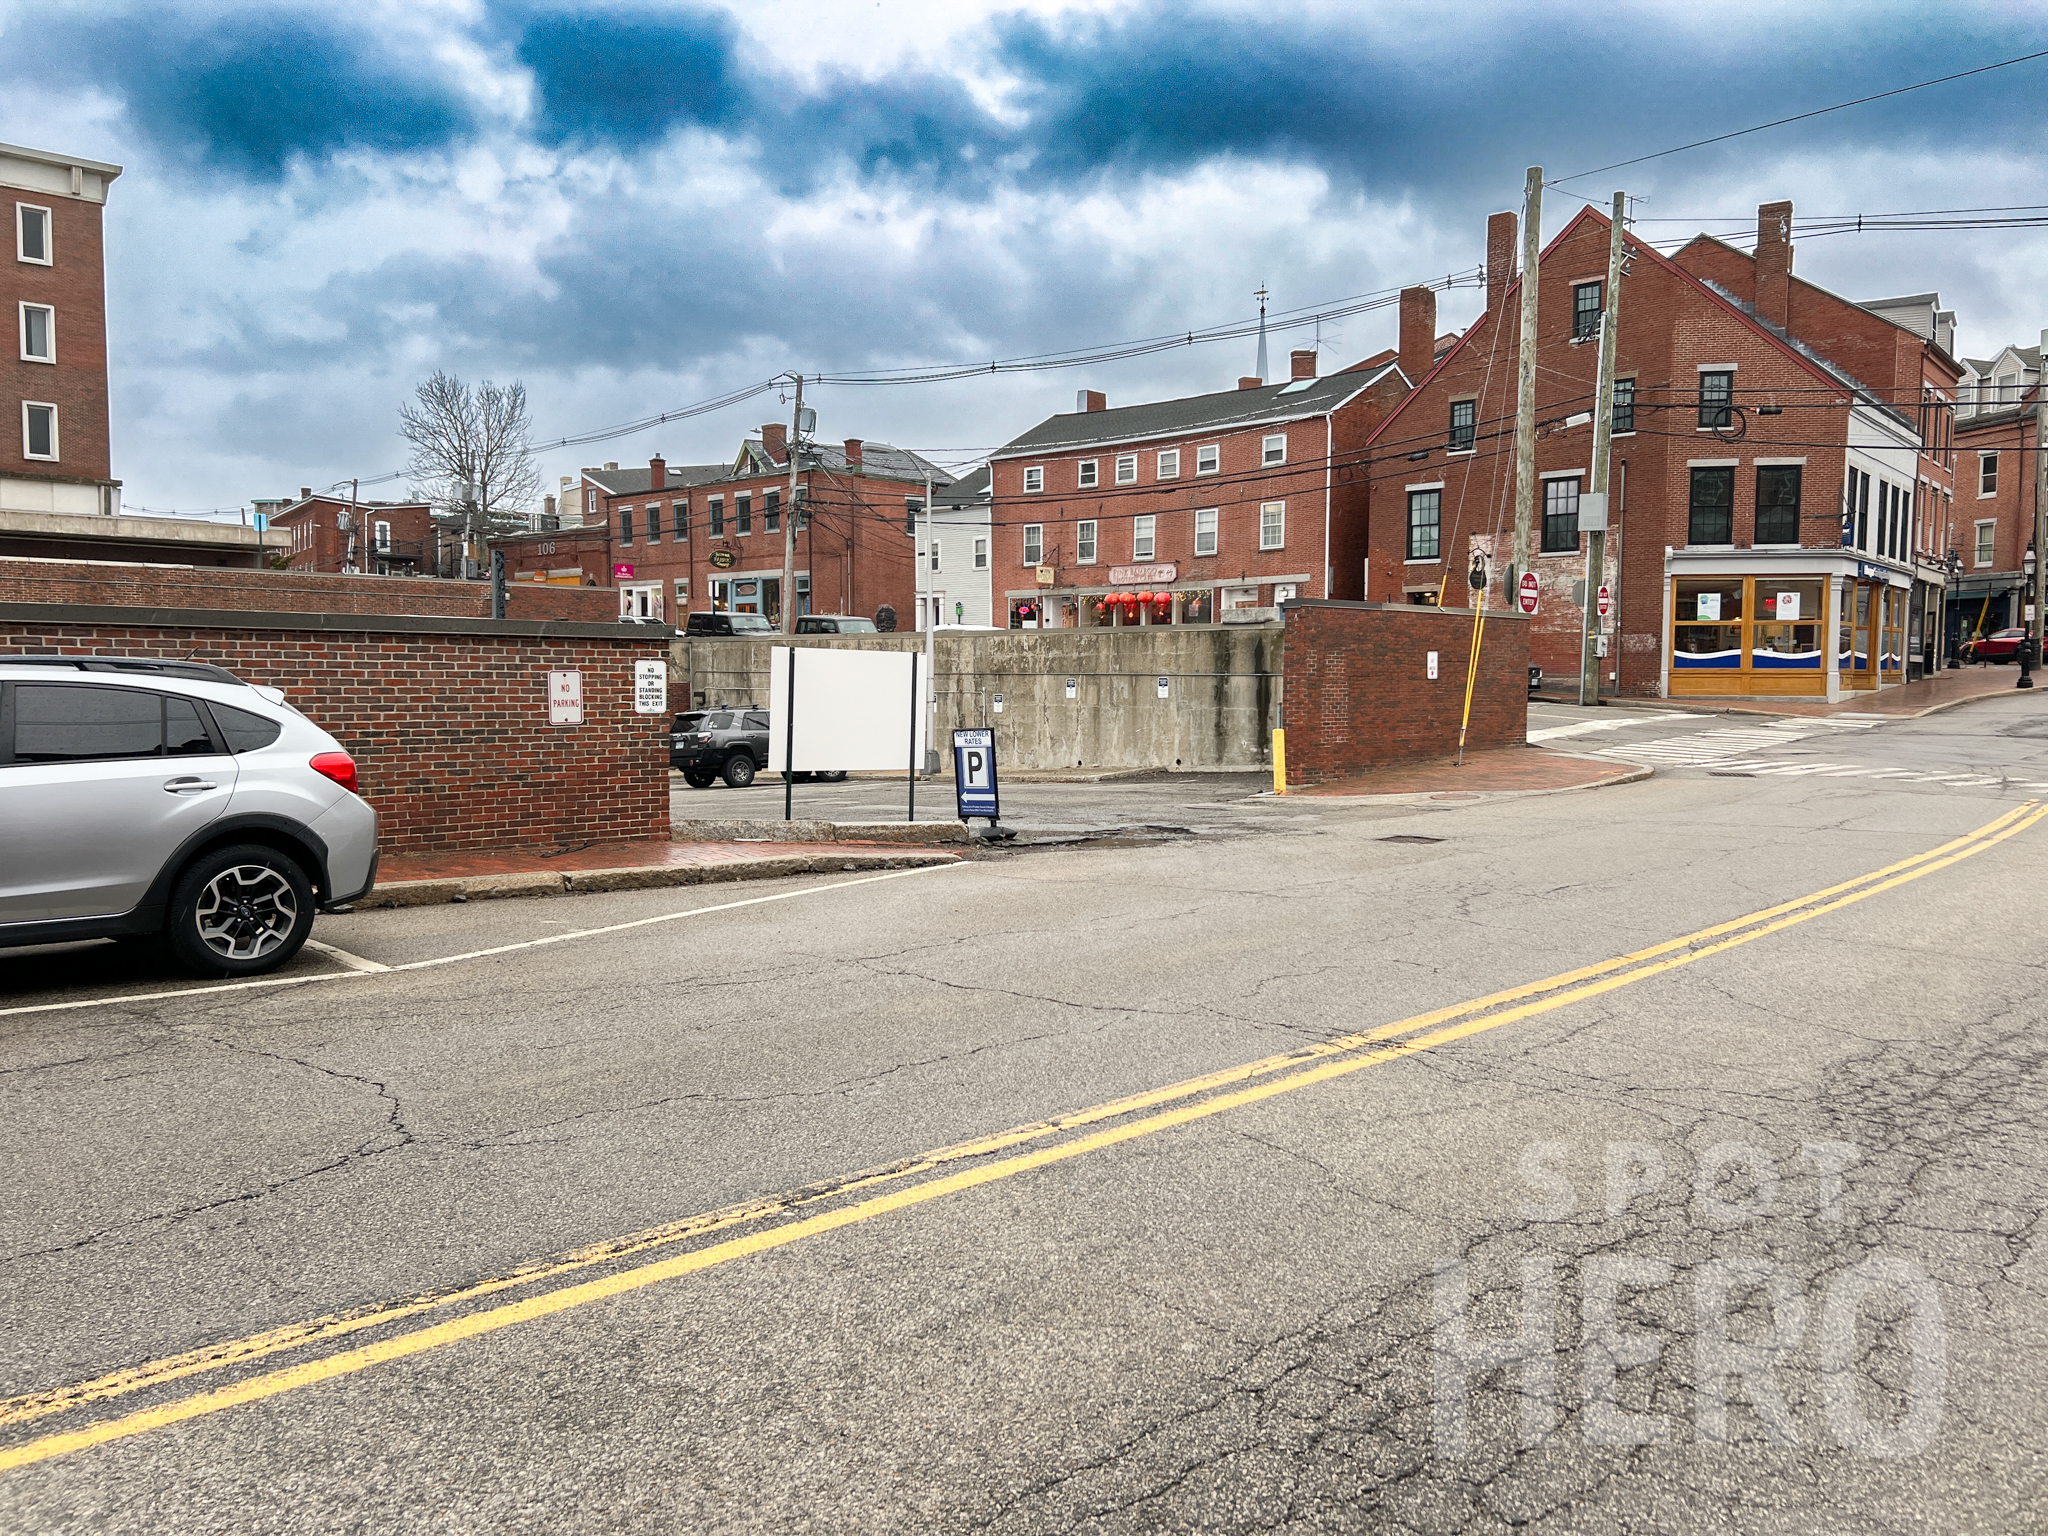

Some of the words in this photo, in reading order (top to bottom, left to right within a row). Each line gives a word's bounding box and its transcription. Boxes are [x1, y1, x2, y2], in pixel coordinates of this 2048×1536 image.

[537, 541, 556, 556] 106
[1528, 580, 1536, 588] NOT
[561, 684, 570, 693] NO
[553, 699, 580, 708] PARKING
[956, 730, 968, 738] NEW
[969, 730, 990, 738] LOWER
[967, 751, 983, 784] P
